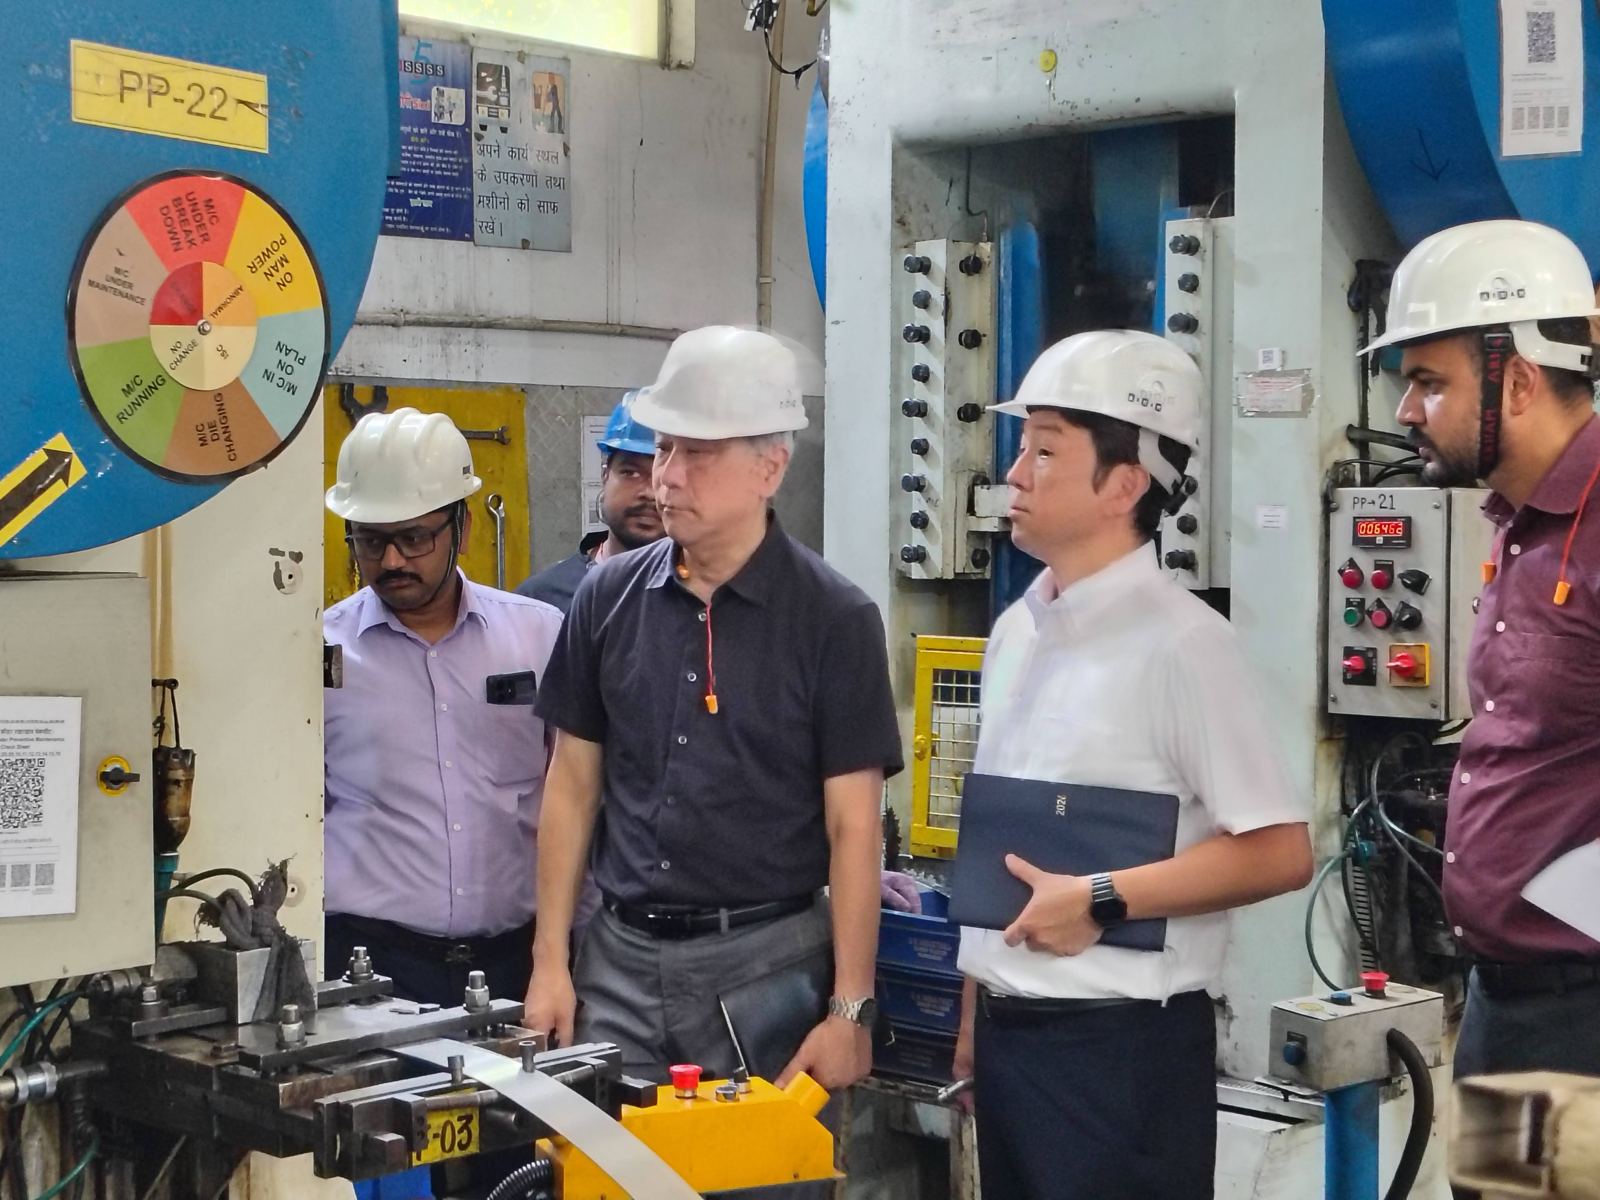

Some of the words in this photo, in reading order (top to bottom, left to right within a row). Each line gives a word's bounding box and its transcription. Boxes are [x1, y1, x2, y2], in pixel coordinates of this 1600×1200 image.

[119, 69, 228, 122] PP-22
[477, 139, 500, 158] अपने
[507, 143, 528, 161] कार्य
[536, 149, 559, 165] स्थल
[477, 164, 487, 182] के
[545, 176, 565, 191] तथा
[185, 191, 210, 245] UNDER
[203, 198, 219, 226] M/C
[517, 194, 529, 213] को
[537, 200, 559, 215] साफ
[159, 205, 183, 252] DOWN
[172, 196, 198, 250] BREAK
[246, 233, 287, 274] POWER
[263, 254, 290, 281] MAN
[88, 279, 146, 306] MAINTENANCE
[105, 274, 134, 290] UNDER
[276, 272, 293, 291] ON
[210, 285, 244, 319] ABNORMAL
[169, 339, 199, 371] CHANGE
[170, 340, 182, 354] NO
[275, 341, 307, 366] PLAN
[262, 368, 275, 383] IN
[276, 359, 294, 376] ON
[116, 374, 166, 424] RUNNING
[121, 374, 143, 398] M/C
[276, 380, 298, 396] M/C
[208, 419, 220, 442] DIE
[214, 392, 237, 462] CHANGING
